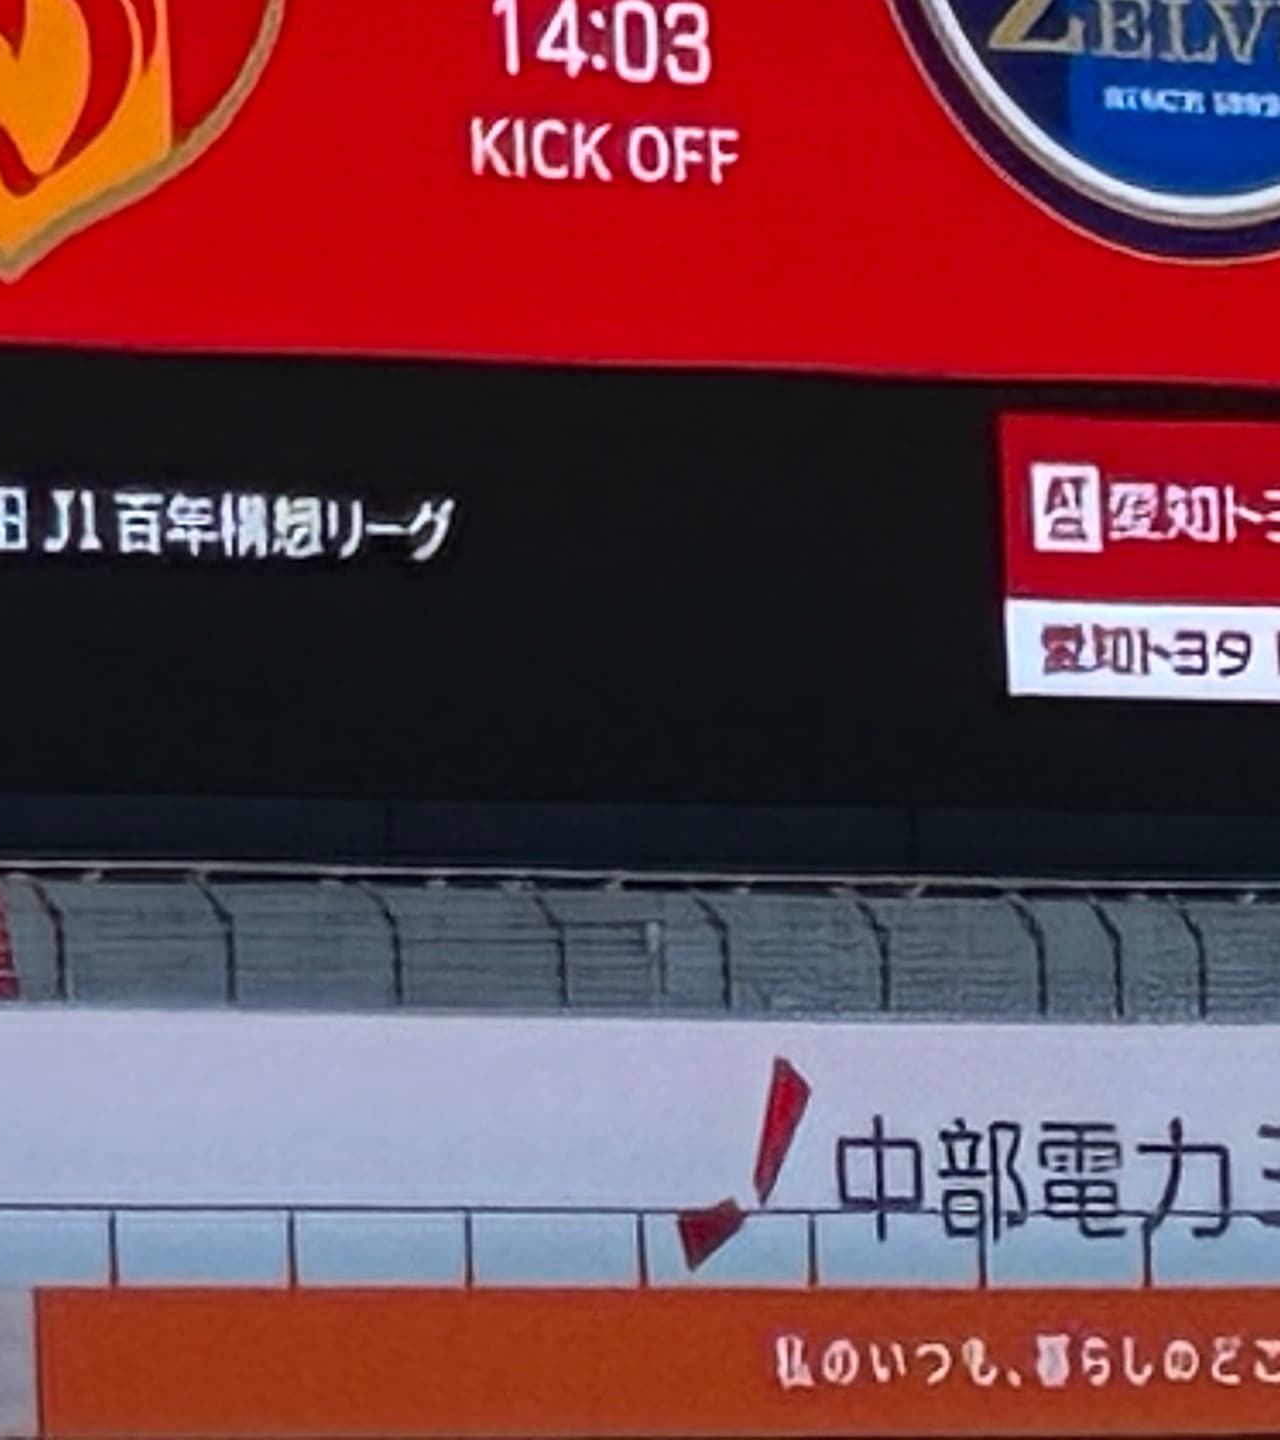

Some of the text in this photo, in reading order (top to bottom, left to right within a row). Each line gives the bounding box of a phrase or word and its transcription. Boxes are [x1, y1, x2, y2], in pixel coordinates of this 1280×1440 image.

[470, 116, 740, 185] KICK OFF
[43, 489, 103, 553] J1
